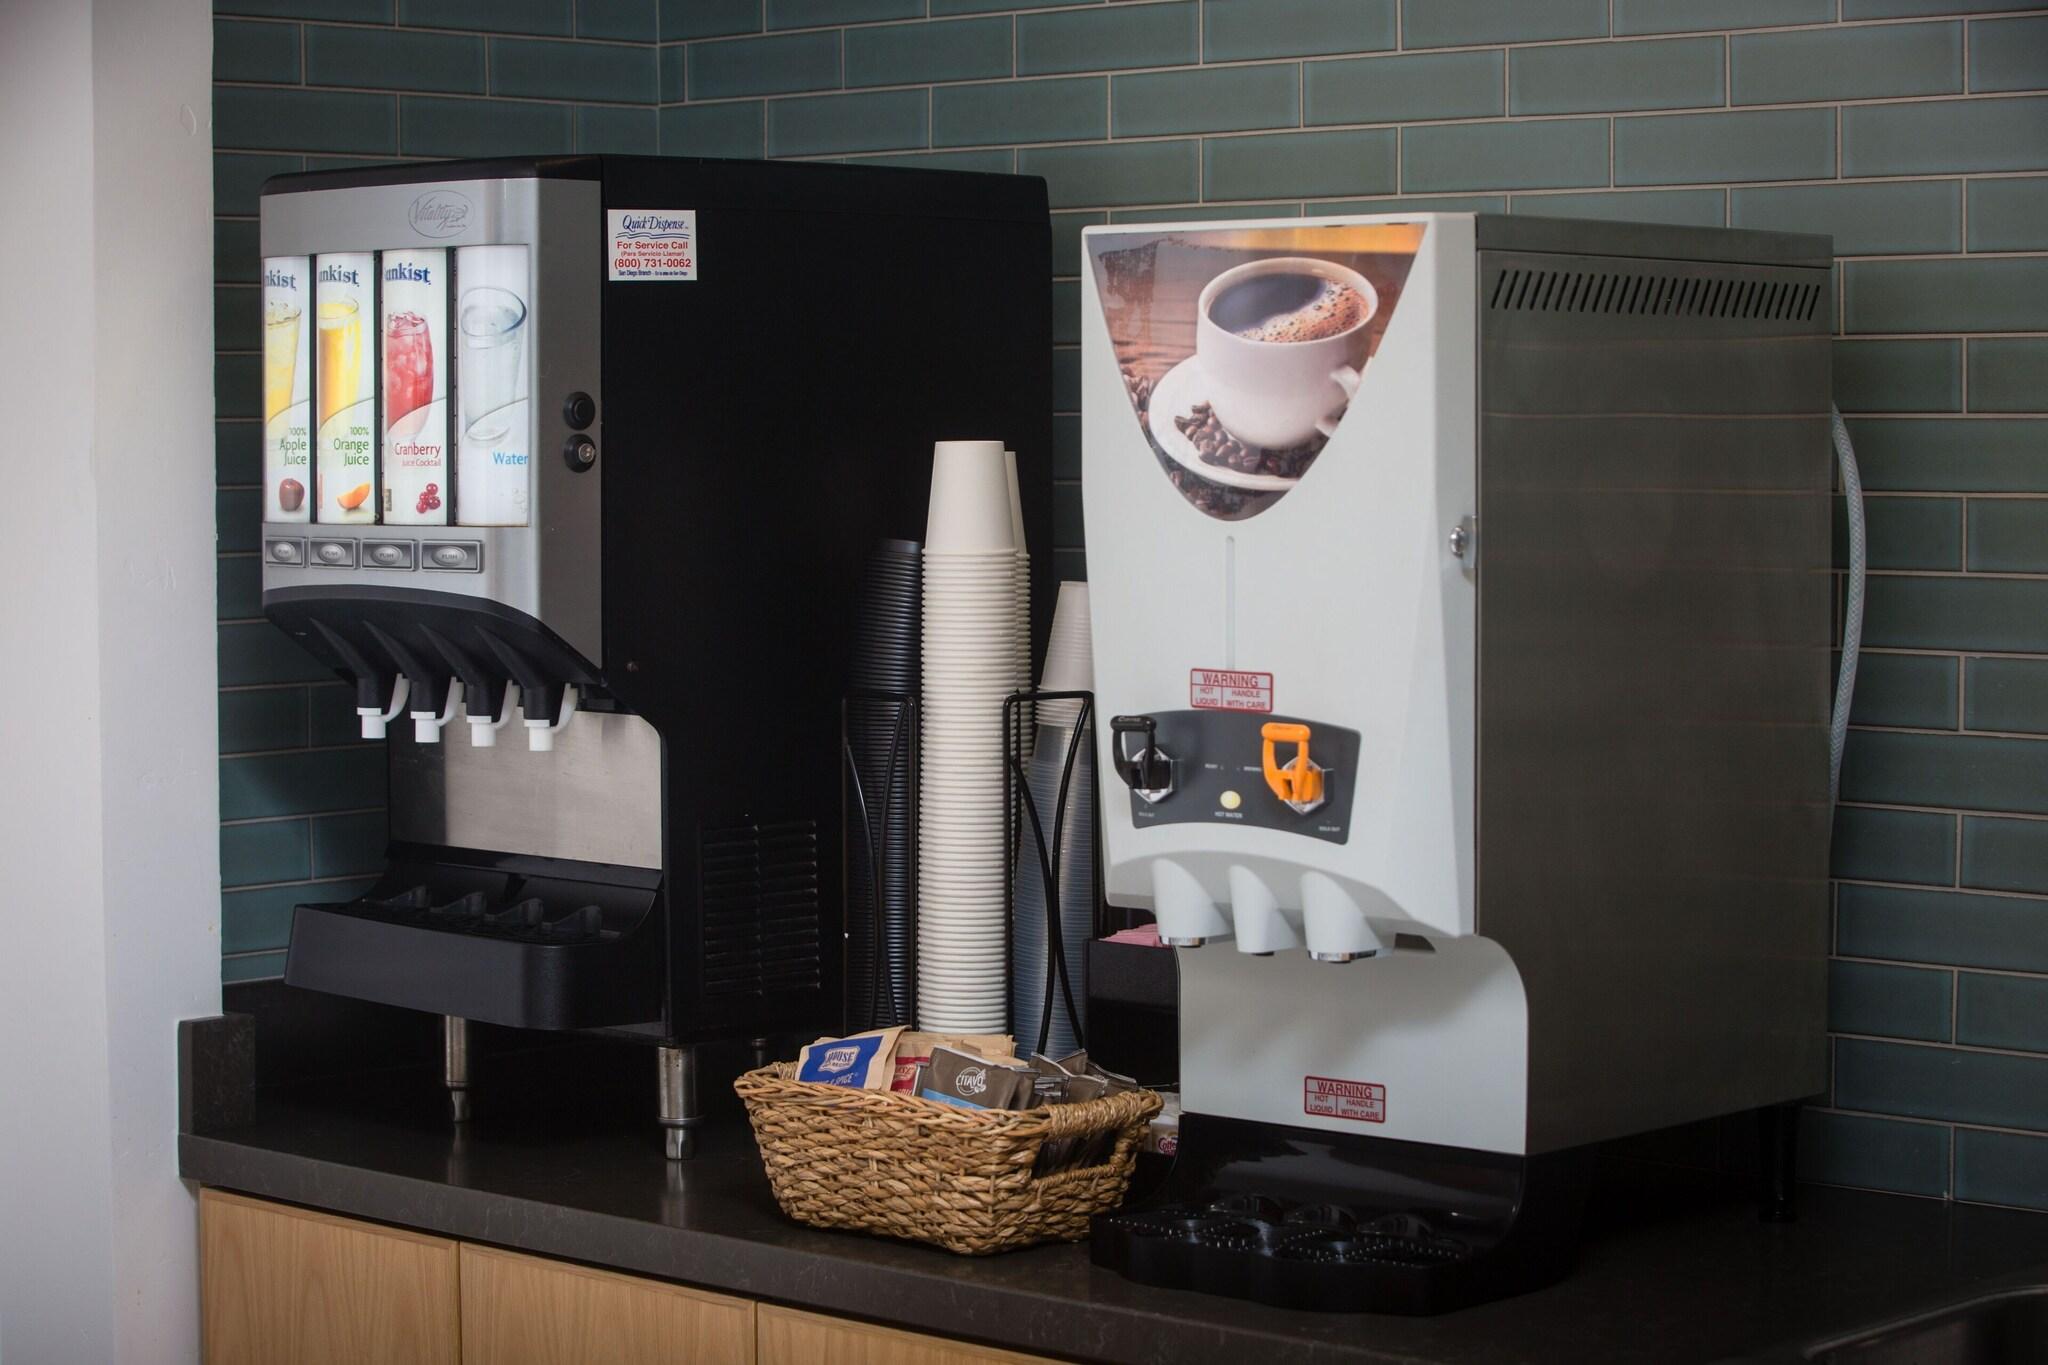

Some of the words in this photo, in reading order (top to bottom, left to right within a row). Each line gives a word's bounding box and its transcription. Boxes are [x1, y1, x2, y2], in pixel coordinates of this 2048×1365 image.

[622, 215, 646, 232] Quick
[648, 216, 685, 231] Dispense
[617, 241, 632, 249] For
[635, 241, 668, 249] Service
[671, 241, 688, 249] Call
[614, 259, 641, 269] (800)
[643, 259, 691, 268] 731-0062
[385, 262, 430, 283] unkist
[350, 426, 369, 436] 100%
[280, 438, 307, 454] Apple
[333, 438, 369, 454] Orange
[394, 442, 441, 458] Cranberry
[284, 451, 307, 466] Juice
[344, 453, 369, 466] Juice
[492, 450, 529, 465] Water
[1202, 672, 1258, 687] WARNING
[1200, 686, 1214, 694] HOT
[1232, 689, 1261, 698] HANDLE
[1196, 697, 1218, 706] LIQUID
[1227, 699, 1245, 708] WITH
[1246, 700, 1266, 710] CARE
[957, 1069, 984, 1089] CITAVO
[1317, 1081, 1372, 1098] WARNING
[1314, 1094, 1329, 1103] HOT
[1346, 1098, 1374, 1108] HANDLE
[1310, 1104, 1334, 1113] LIQUID
[1341, 1108, 1359, 1116] WITH
[1360, 1110, 1380, 1119] CARE
